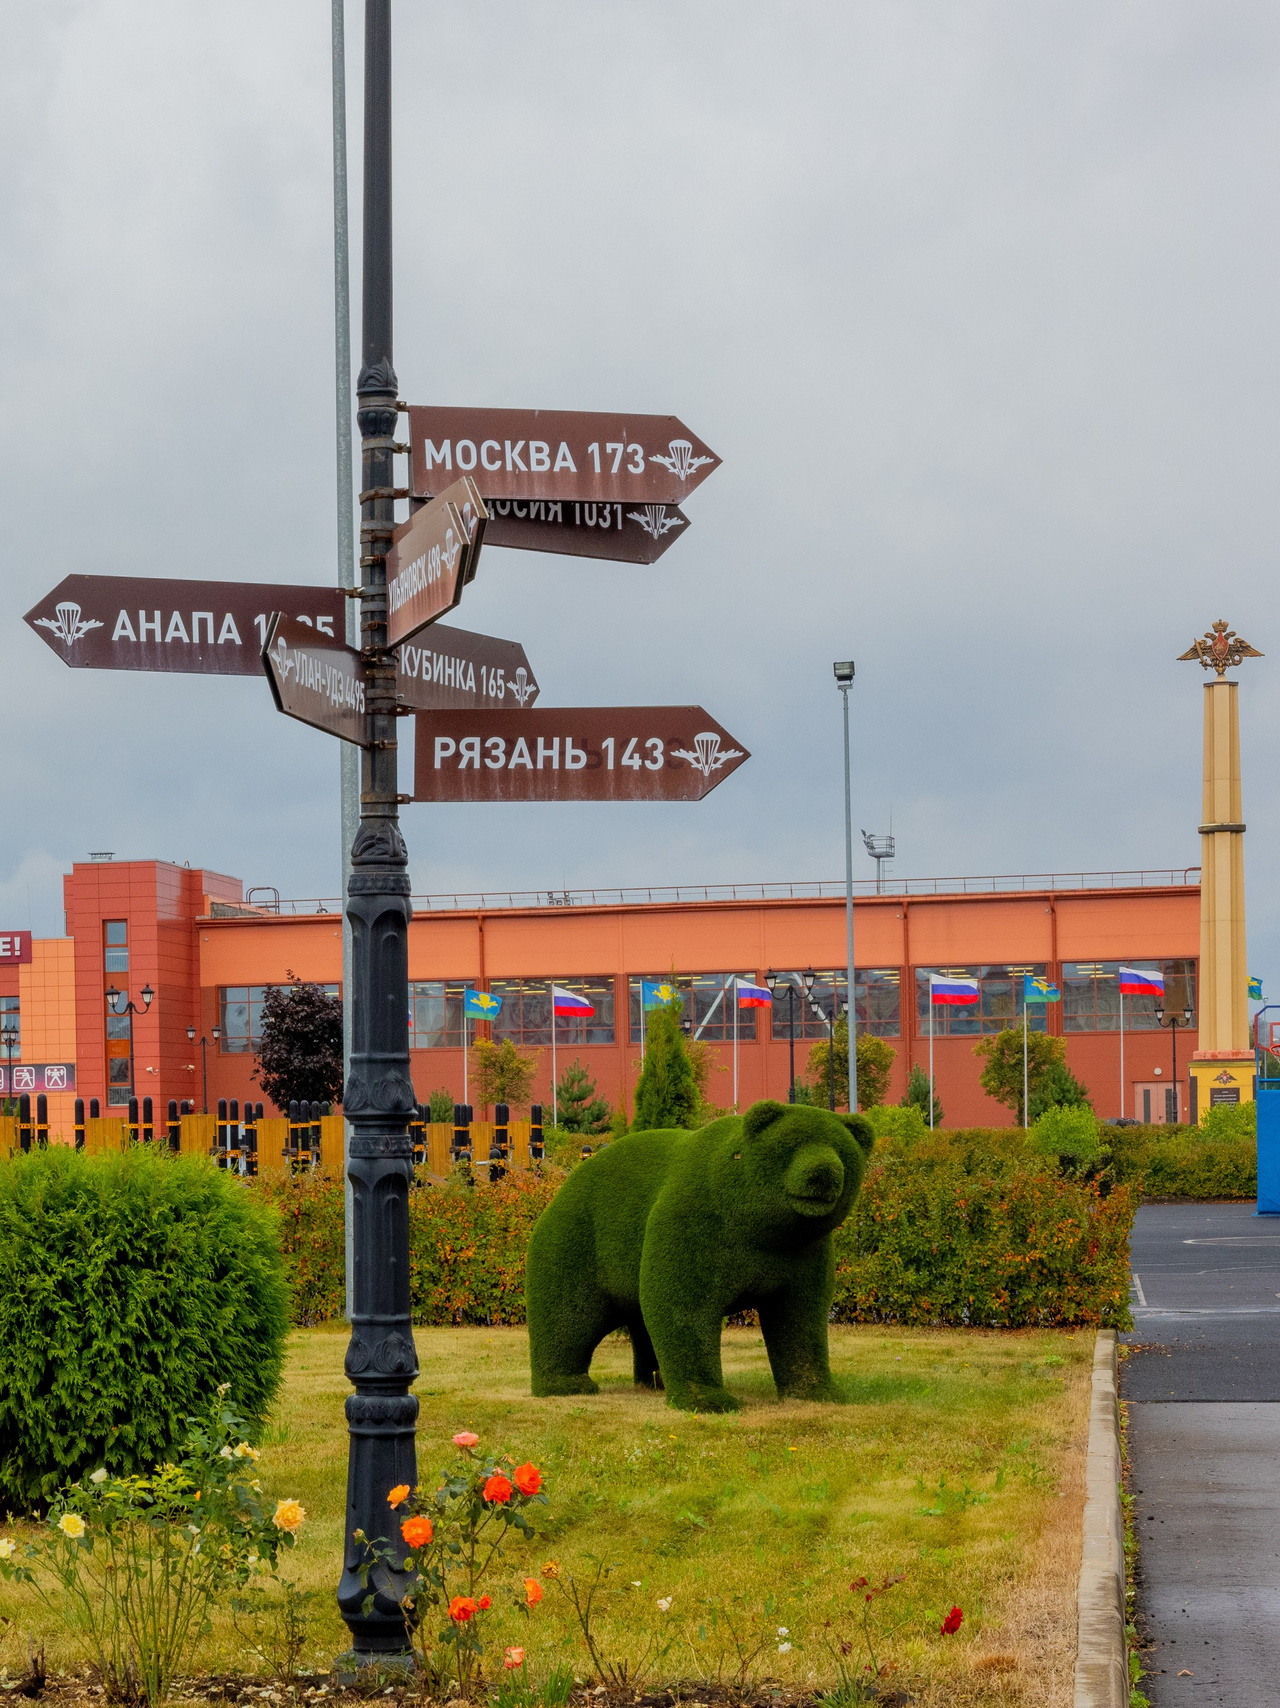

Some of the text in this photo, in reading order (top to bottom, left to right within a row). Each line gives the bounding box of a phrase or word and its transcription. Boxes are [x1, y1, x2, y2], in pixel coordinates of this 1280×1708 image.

[424, 439, 646, 475] МОСКВА 173
[388, 543, 441, 616] УЛЬЯНОВСК 698
[111, 609, 335, 646] АНАПА 15
[293, 649, 366, 714] УЛАН-УДЭ 4495
[401, 644, 506, 700] КУБИНКА 165
[434, 736, 665, 771] РЯЗАНЬ 143
